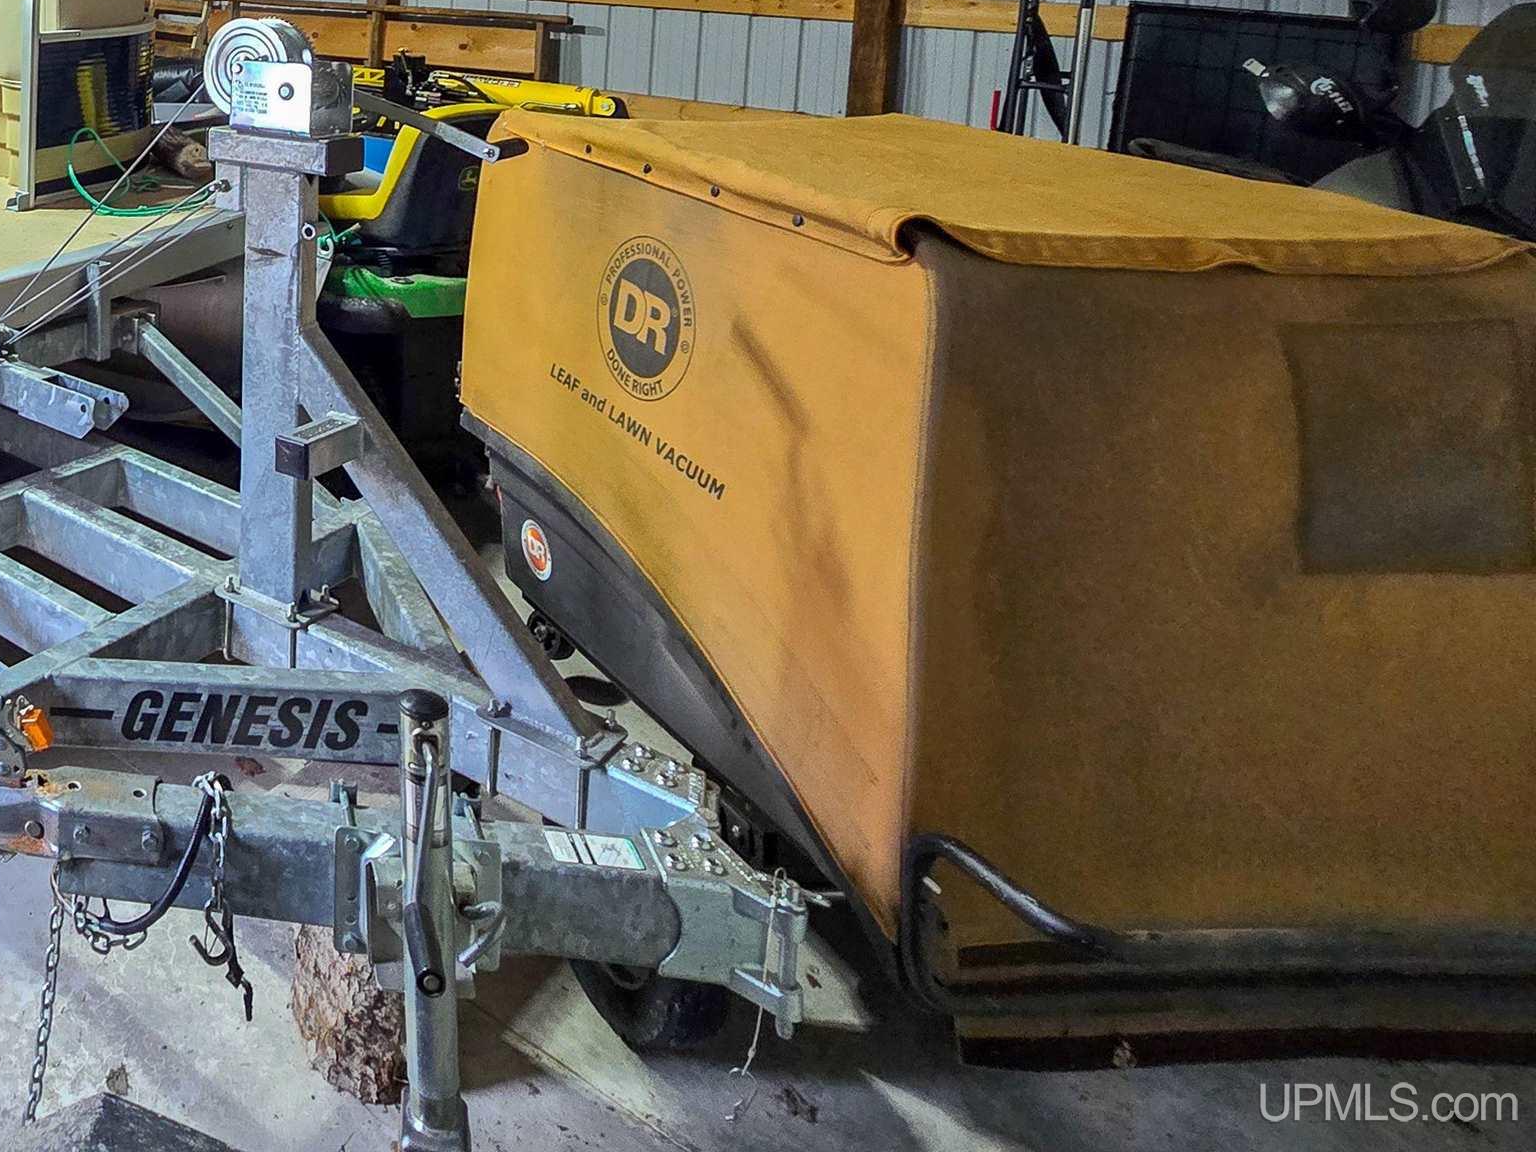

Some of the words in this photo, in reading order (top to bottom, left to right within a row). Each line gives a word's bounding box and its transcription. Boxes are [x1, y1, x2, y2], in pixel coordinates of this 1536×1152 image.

[605, 243, 671, 285] PROFESSIONAL
[671, 268, 693, 328] POWER
[614, 277, 672, 356] DR
[606, 348, 632, 387] DONE
[631, 379, 664, 397] RIGHT
[549, 363, 582, 393] LEAF
[580, 388, 607, 413] and
[608, 405, 653, 447] LAWN
[655, 437, 727, 501] VACUUM
[120, 689, 369, 751] GENESIS
